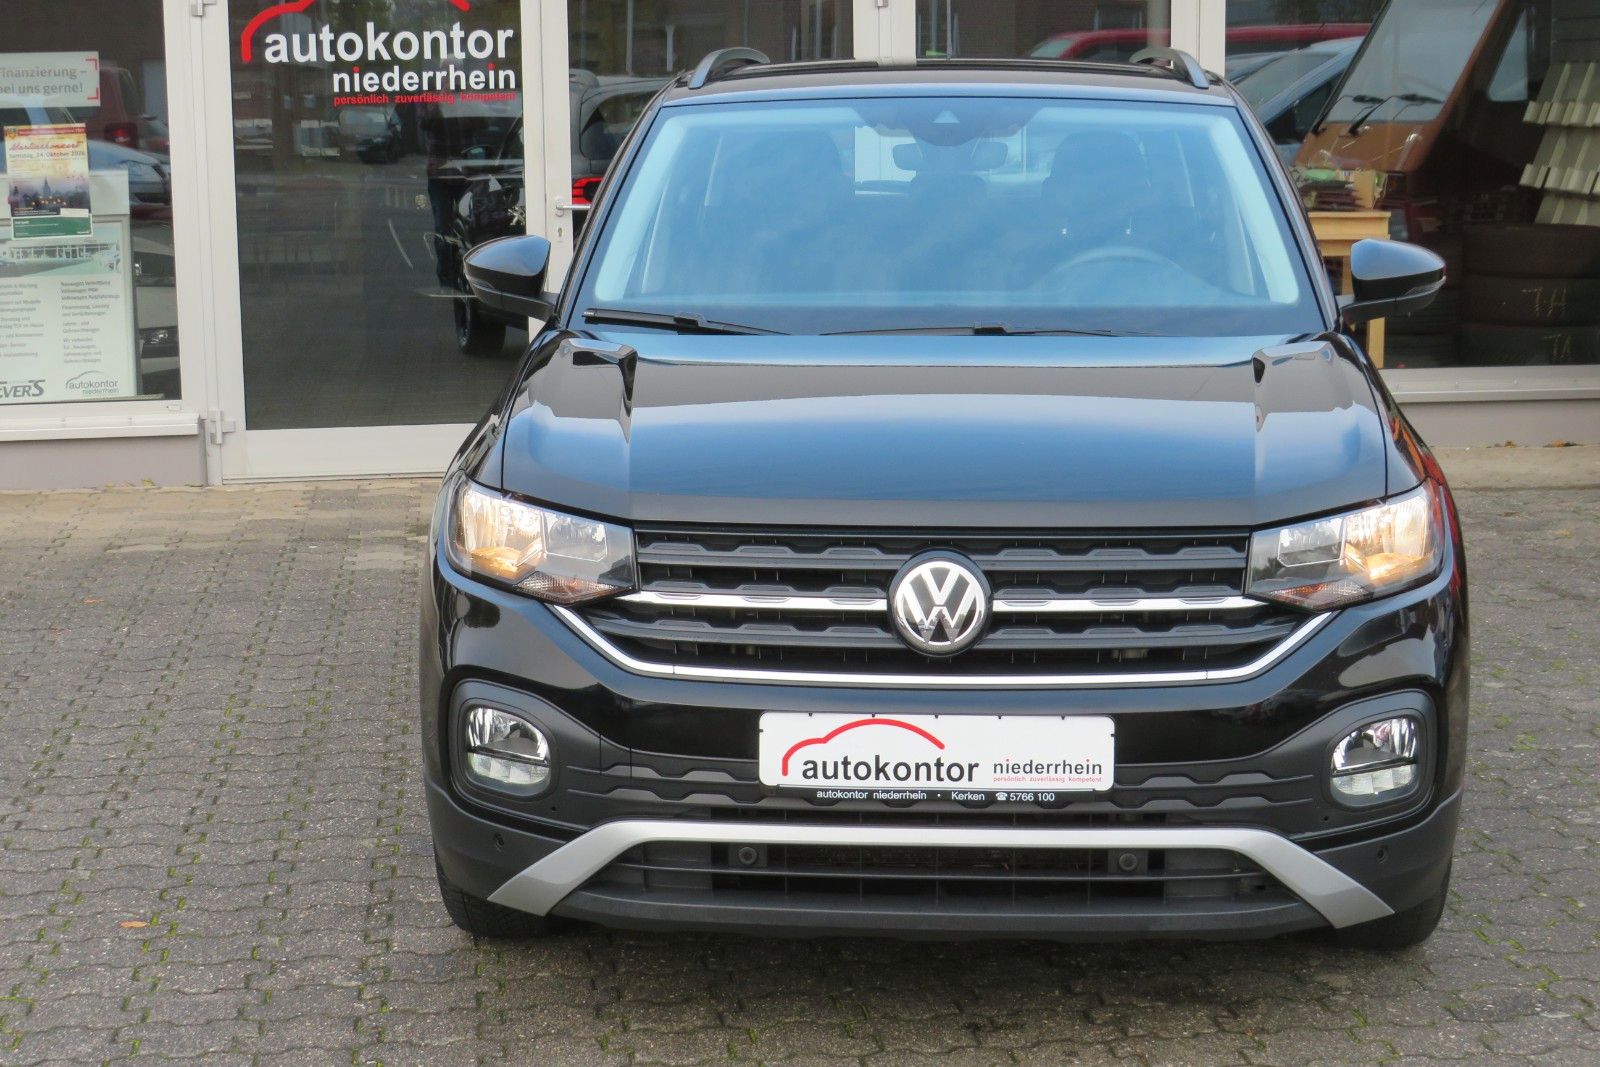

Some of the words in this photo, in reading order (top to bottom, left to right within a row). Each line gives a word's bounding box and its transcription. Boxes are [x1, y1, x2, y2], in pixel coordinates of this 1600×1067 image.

[264, 21, 514, 63] autokontor
[333, 63, 516, 93] niederrhein
[18, 84, 40, 95] uns
[43, 83, 83, 95] gerne!
[333, 94, 389, 107] persönlich
[395, 92, 456, 106] zuverlässig
[69, 379, 118, 390] autokontor
[801, 754, 980, 783] autokontor
[993, 758, 1102, 775] niederrhein
[816, 789, 868, 799] autokontor
[873, 789, 927, 800] niederrhein
[951, 791, 985, 801] Kerken
[1009, 792, 1034, 802] 5766
[1037, 792, 1055, 802] 100
